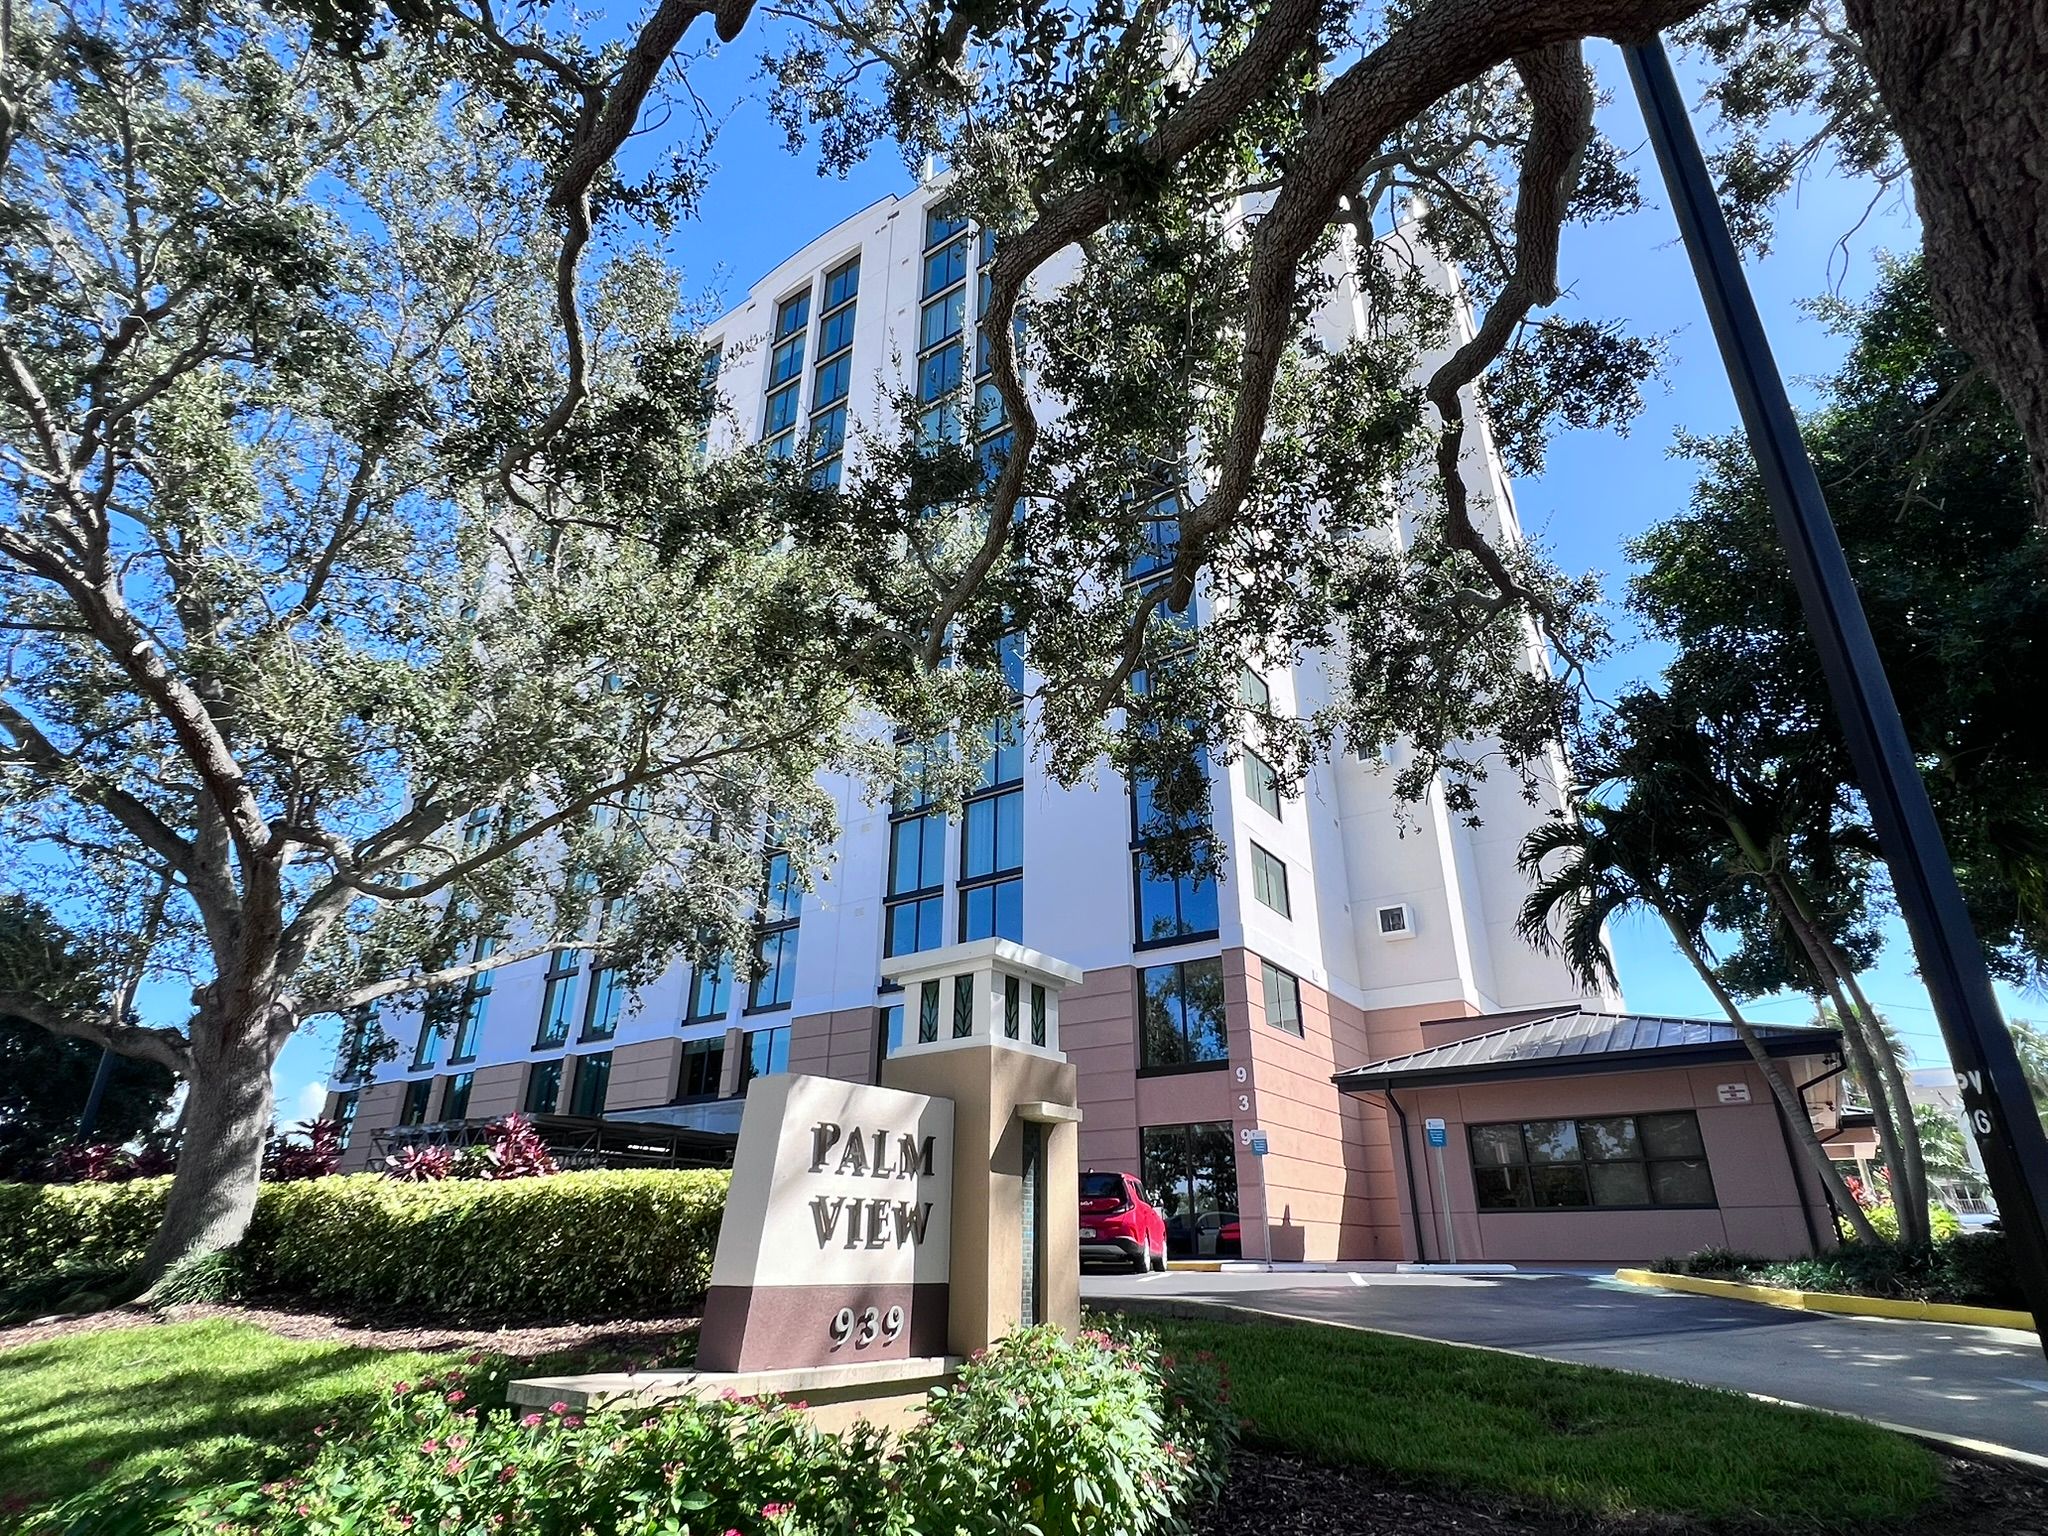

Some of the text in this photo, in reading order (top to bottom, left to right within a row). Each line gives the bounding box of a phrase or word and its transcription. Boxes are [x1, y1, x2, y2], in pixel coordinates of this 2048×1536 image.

[808, 1121, 937, 1181] PALM
[808, 1195, 934, 1250] VIEW
[830, 1305, 905, 1352] 939
